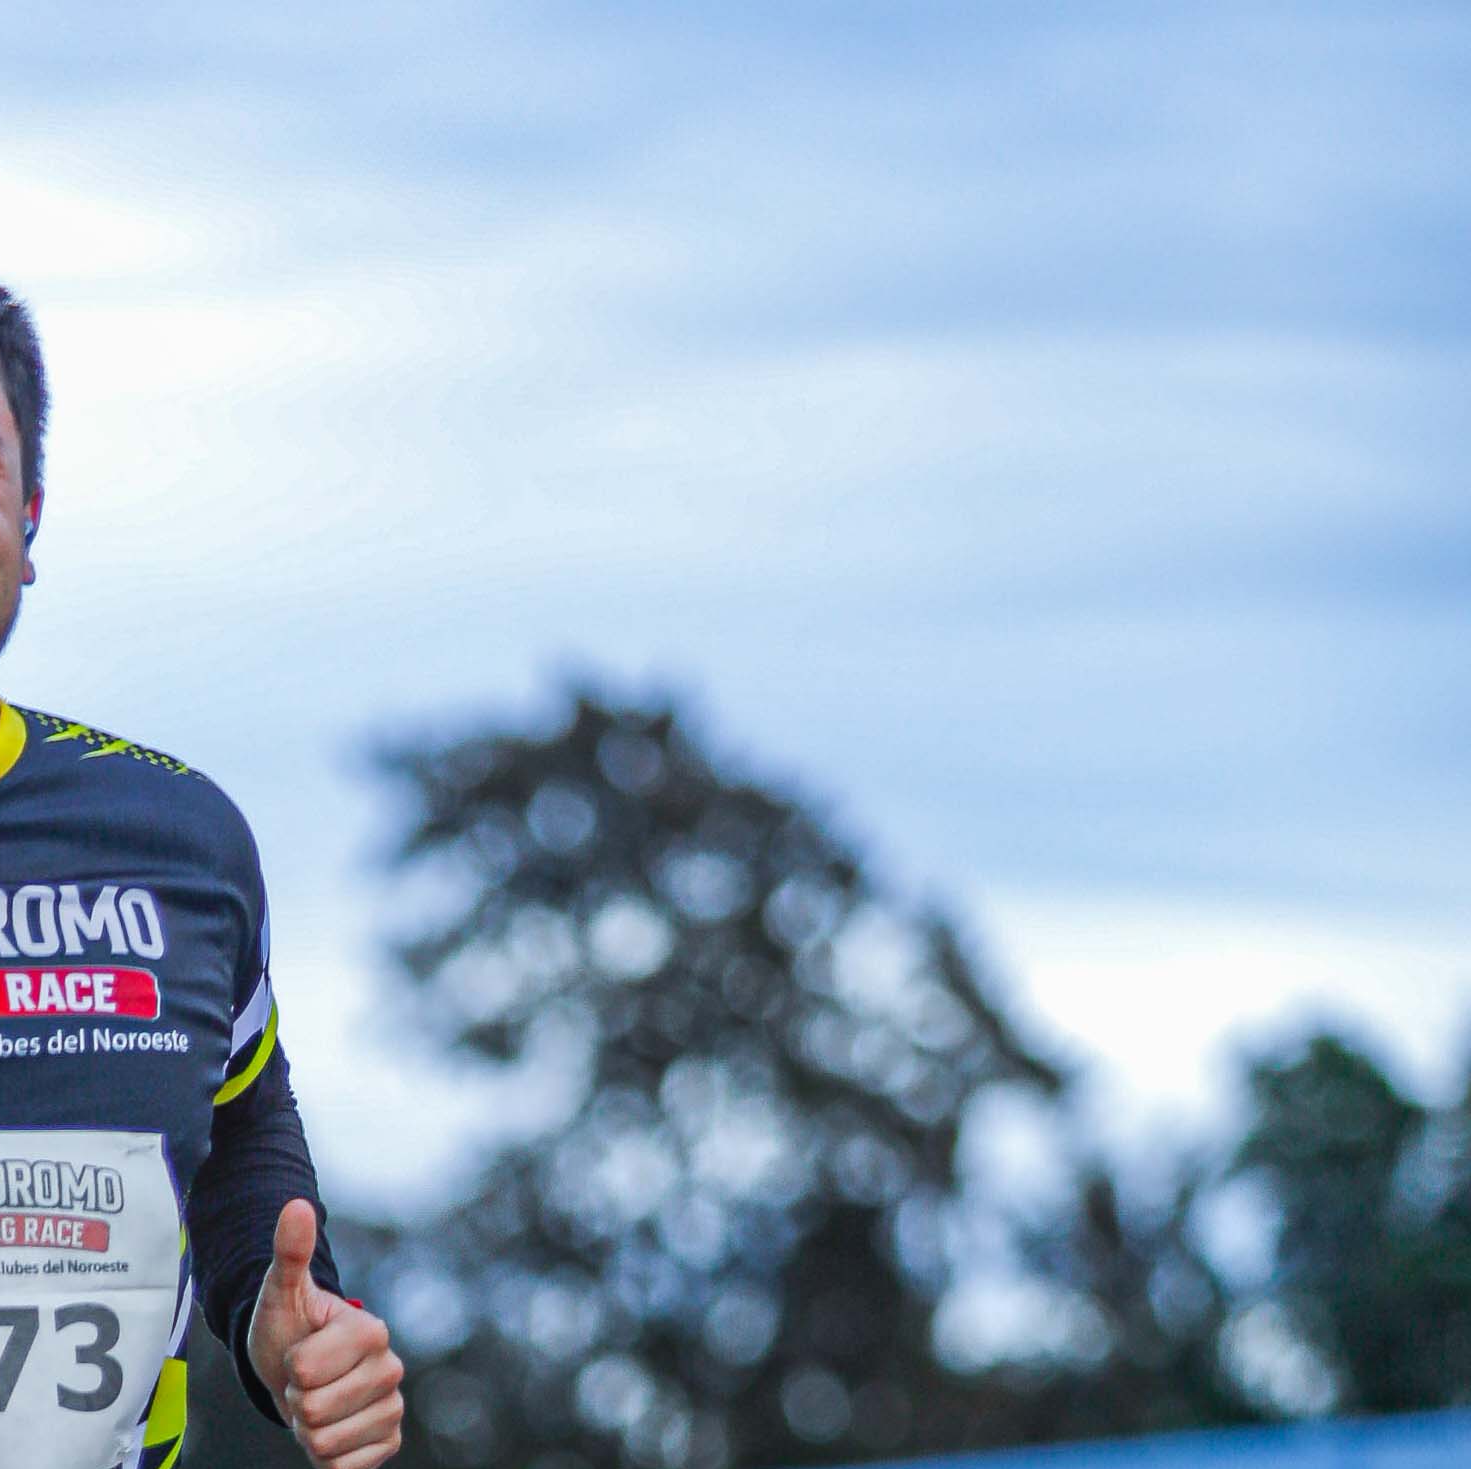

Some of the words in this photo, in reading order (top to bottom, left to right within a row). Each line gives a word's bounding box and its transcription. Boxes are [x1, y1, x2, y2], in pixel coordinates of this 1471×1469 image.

[4, 972, 117, 1013] RACE
[47, 1028, 85, 1054] del
[92, 1027, 189, 1053] Noroeste
[24, 1215, 84, 1248] RACE
[43, 1259, 64, 1274] del
[67, 1260, 129, 1274] Noroeste
